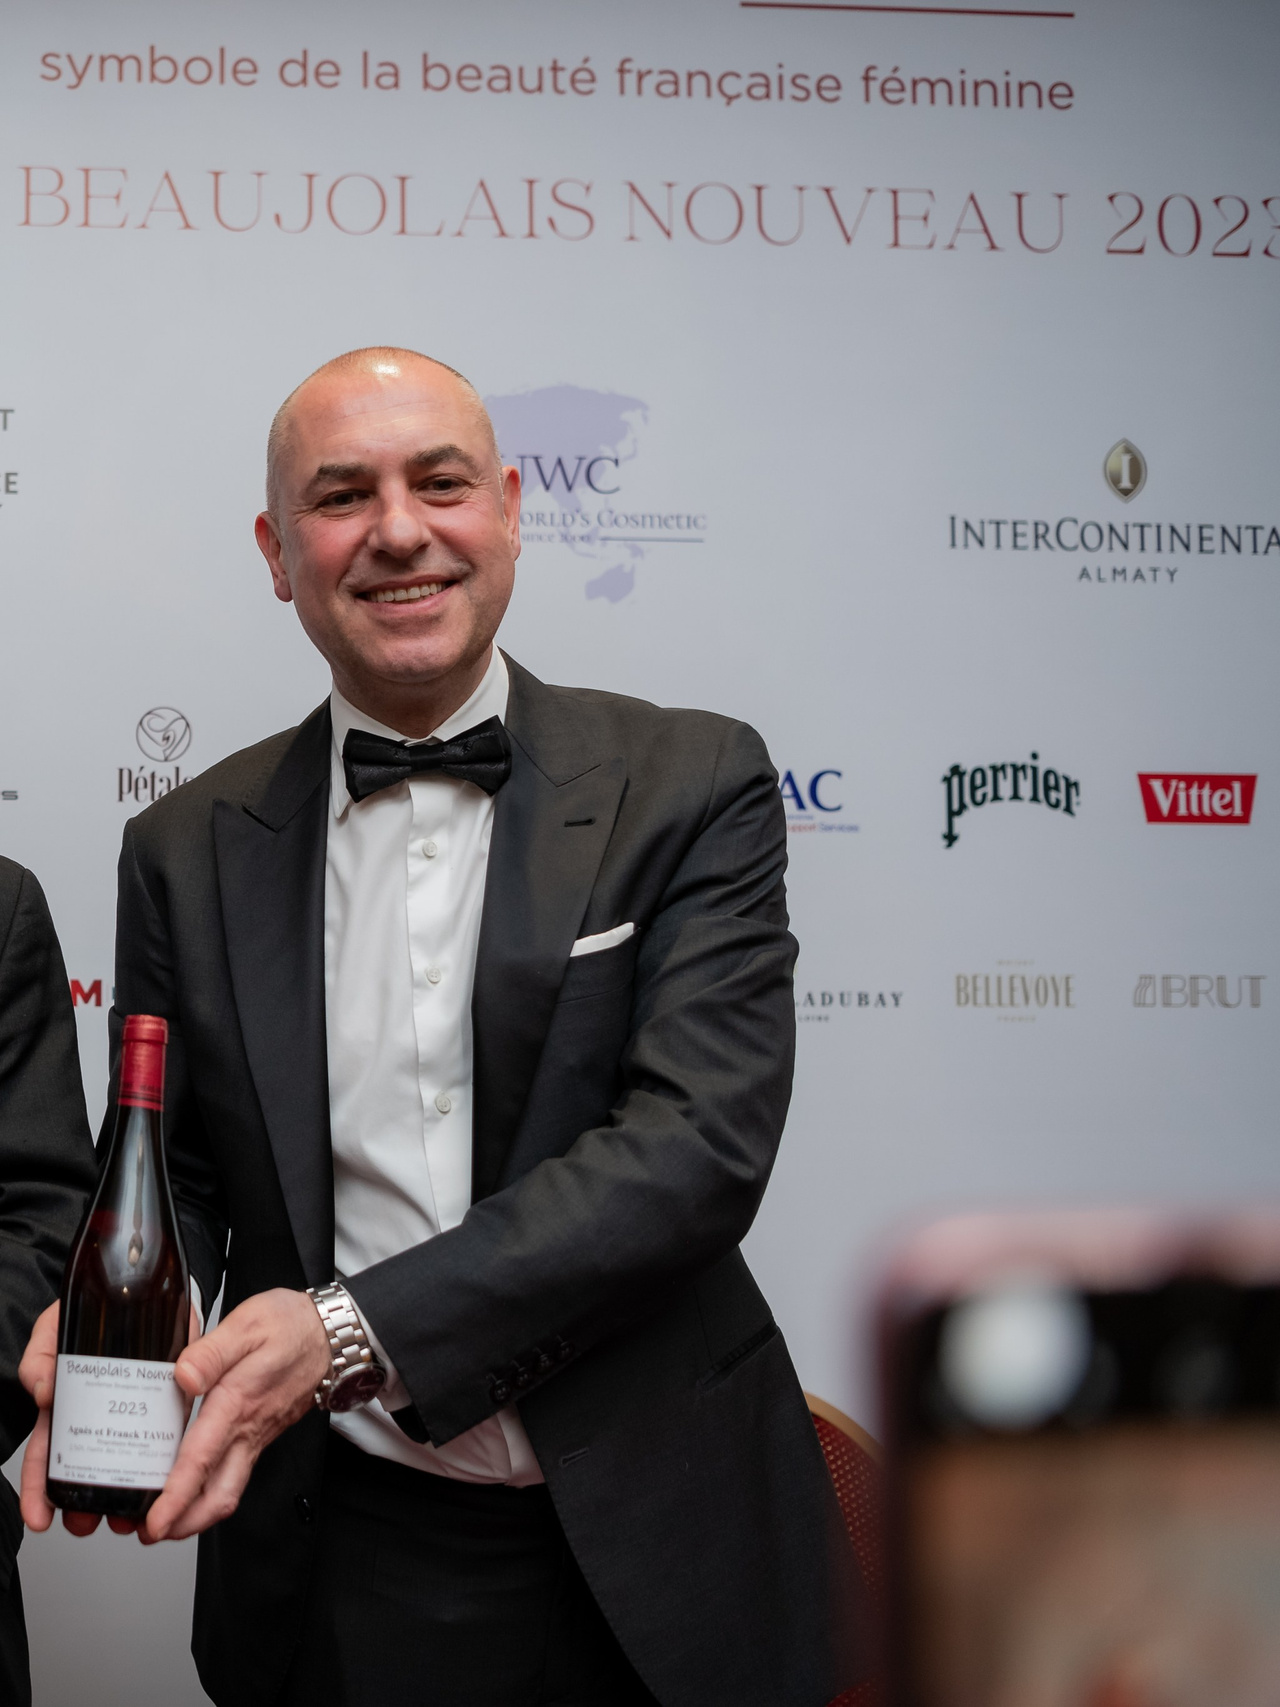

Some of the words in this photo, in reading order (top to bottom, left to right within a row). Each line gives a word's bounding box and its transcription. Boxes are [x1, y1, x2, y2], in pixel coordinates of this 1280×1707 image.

[39, 44, 259, 90] symbole
[278, 48, 342, 89] de
[361, 49, 402, 91] la
[421, 51, 598, 97] beauté
[616, 57, 843, 107] française
[861, 64, 1075, 111] féminine
[18, 165, 596, 241] BEAUJOLAIS
[625, 180, 1070, 255] NOUVEAU
[1077, 566, 1179, 584] ALMATY
[117, 765, 194, 803] Pétal
[1147, 778, 1245, 818] Vittel
[954, 973, 1076, 1009] BELLEVOYE
[1161, 974, 1268, 1009] BRUT
[66, 1359, 131, 1379] Beaujolais
[136, 1367, 177, 1382] Nouve
[107, 1400, 149, 1416] 2023
